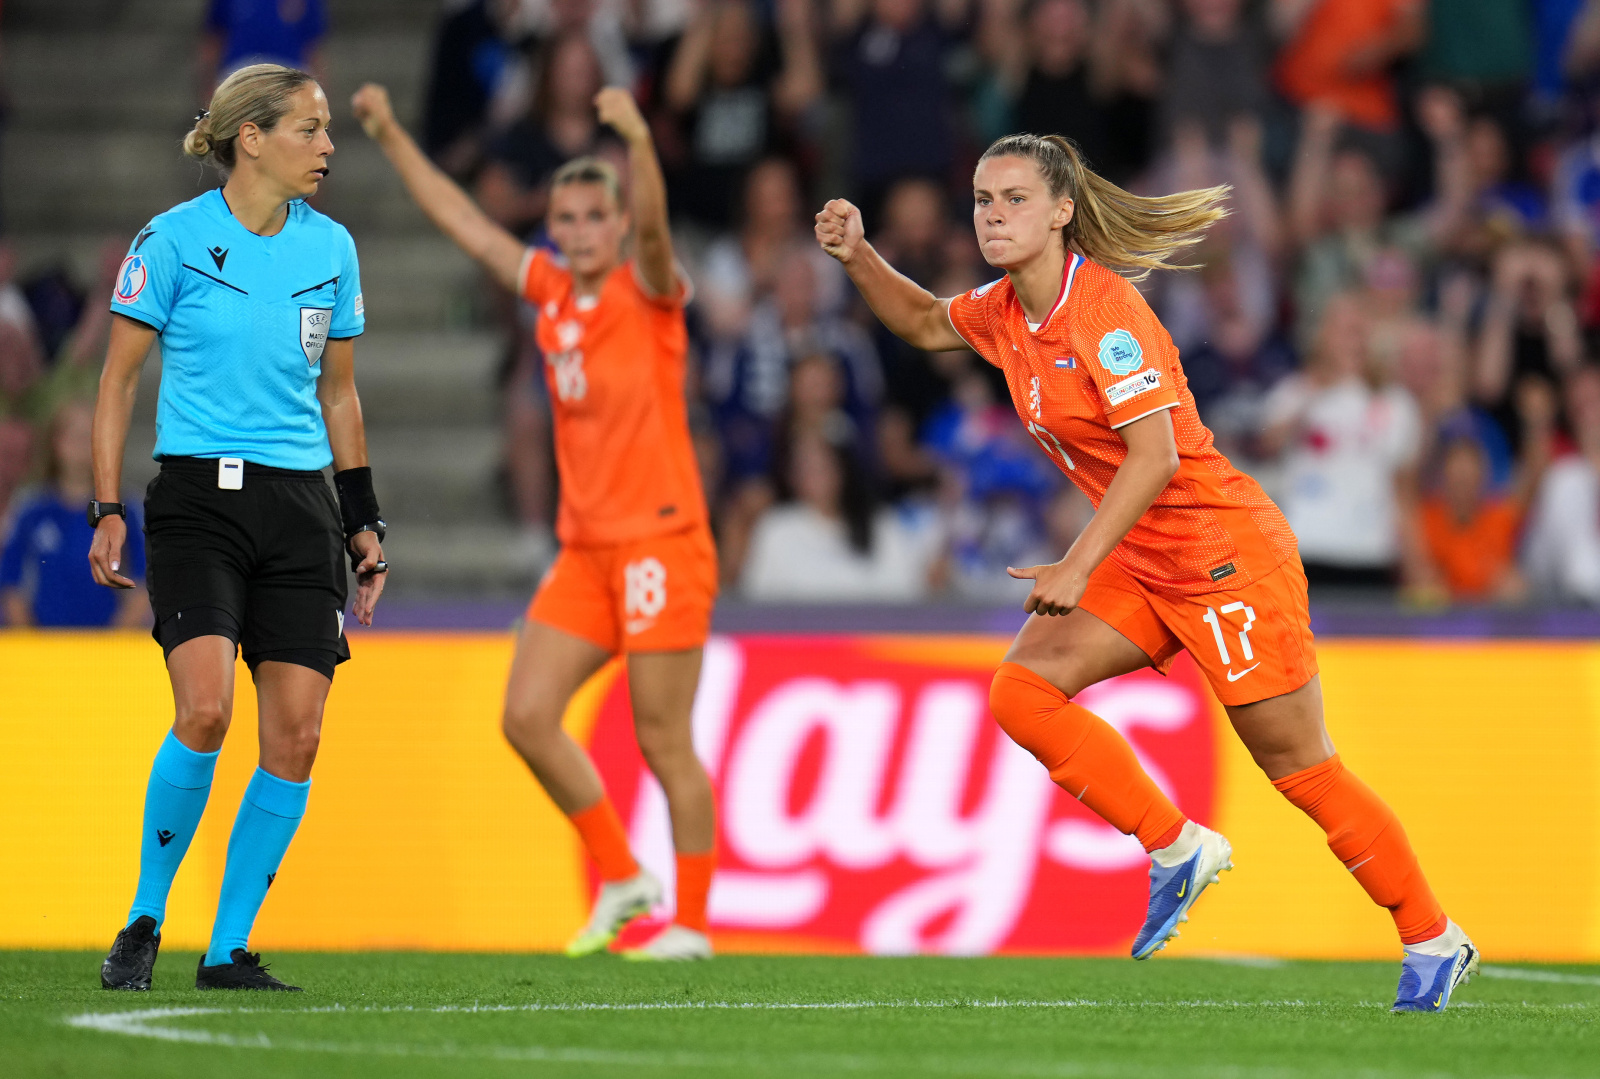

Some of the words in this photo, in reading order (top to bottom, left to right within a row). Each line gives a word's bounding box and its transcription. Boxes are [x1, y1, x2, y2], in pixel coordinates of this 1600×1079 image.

[305, 341, 324, 349] OFFICIA
[624, 557, 667, 617] 18
[1202, 600, 1257, 666] 17
